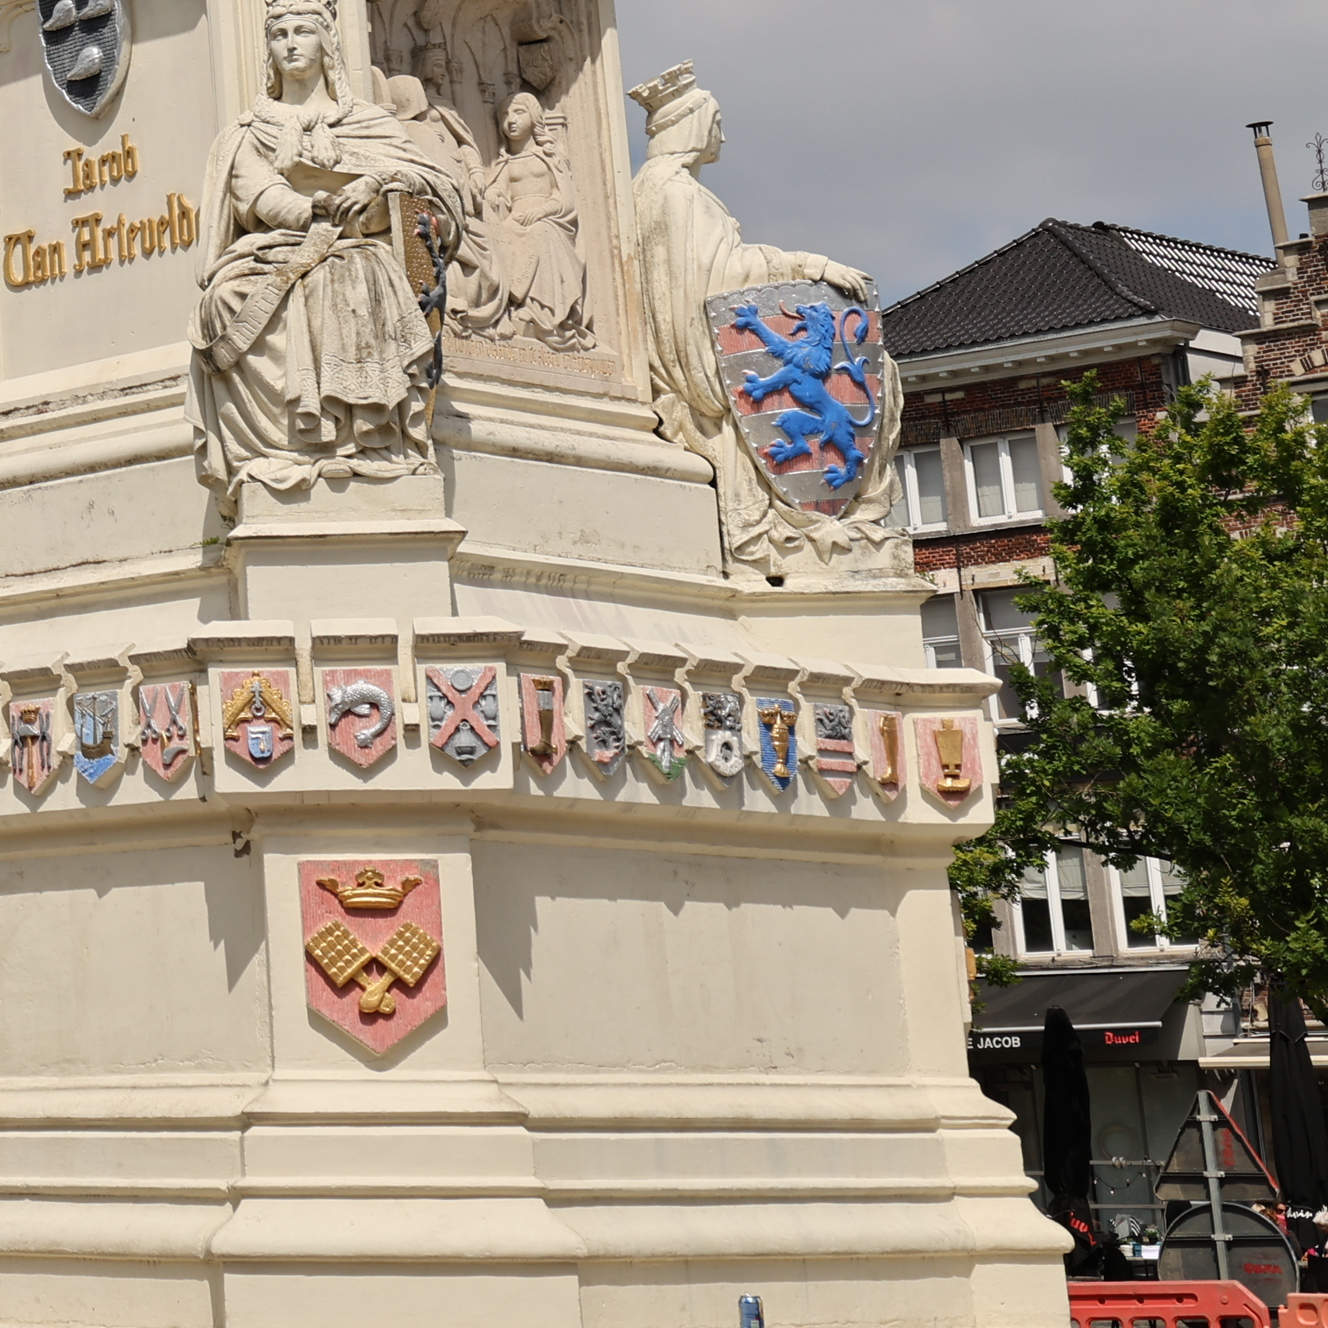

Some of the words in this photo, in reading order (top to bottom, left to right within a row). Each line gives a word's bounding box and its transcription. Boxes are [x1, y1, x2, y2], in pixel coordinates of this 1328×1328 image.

[72, 193, 201, 272] Arteveld
[977, 1036, 1021, 1049] JACOB
[1104, 1031, 1140, 1045] Duvel
